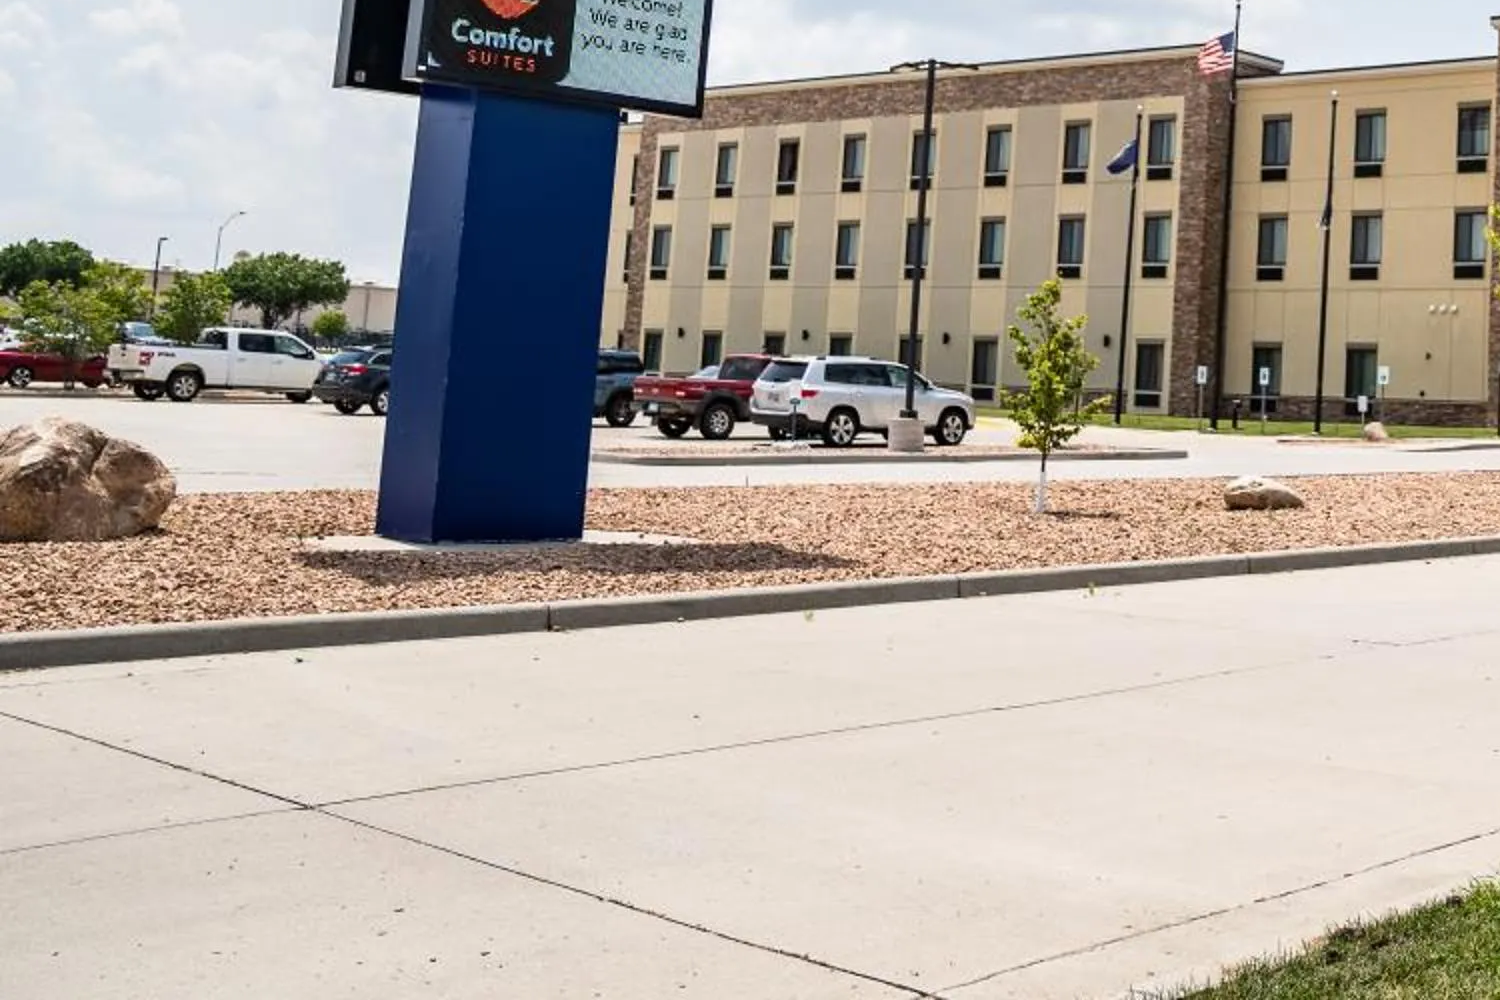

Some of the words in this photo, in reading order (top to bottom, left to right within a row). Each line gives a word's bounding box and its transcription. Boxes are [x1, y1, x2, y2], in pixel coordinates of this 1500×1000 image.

[450, 17, 556, 58] Comfort
[589, 7, 617, 29] We
[623, 18, 649, 34] are
[655, 23, 687, 41] gad
[467, 49, 537, 73] SUITES
[620, 39, 646, 55] are
